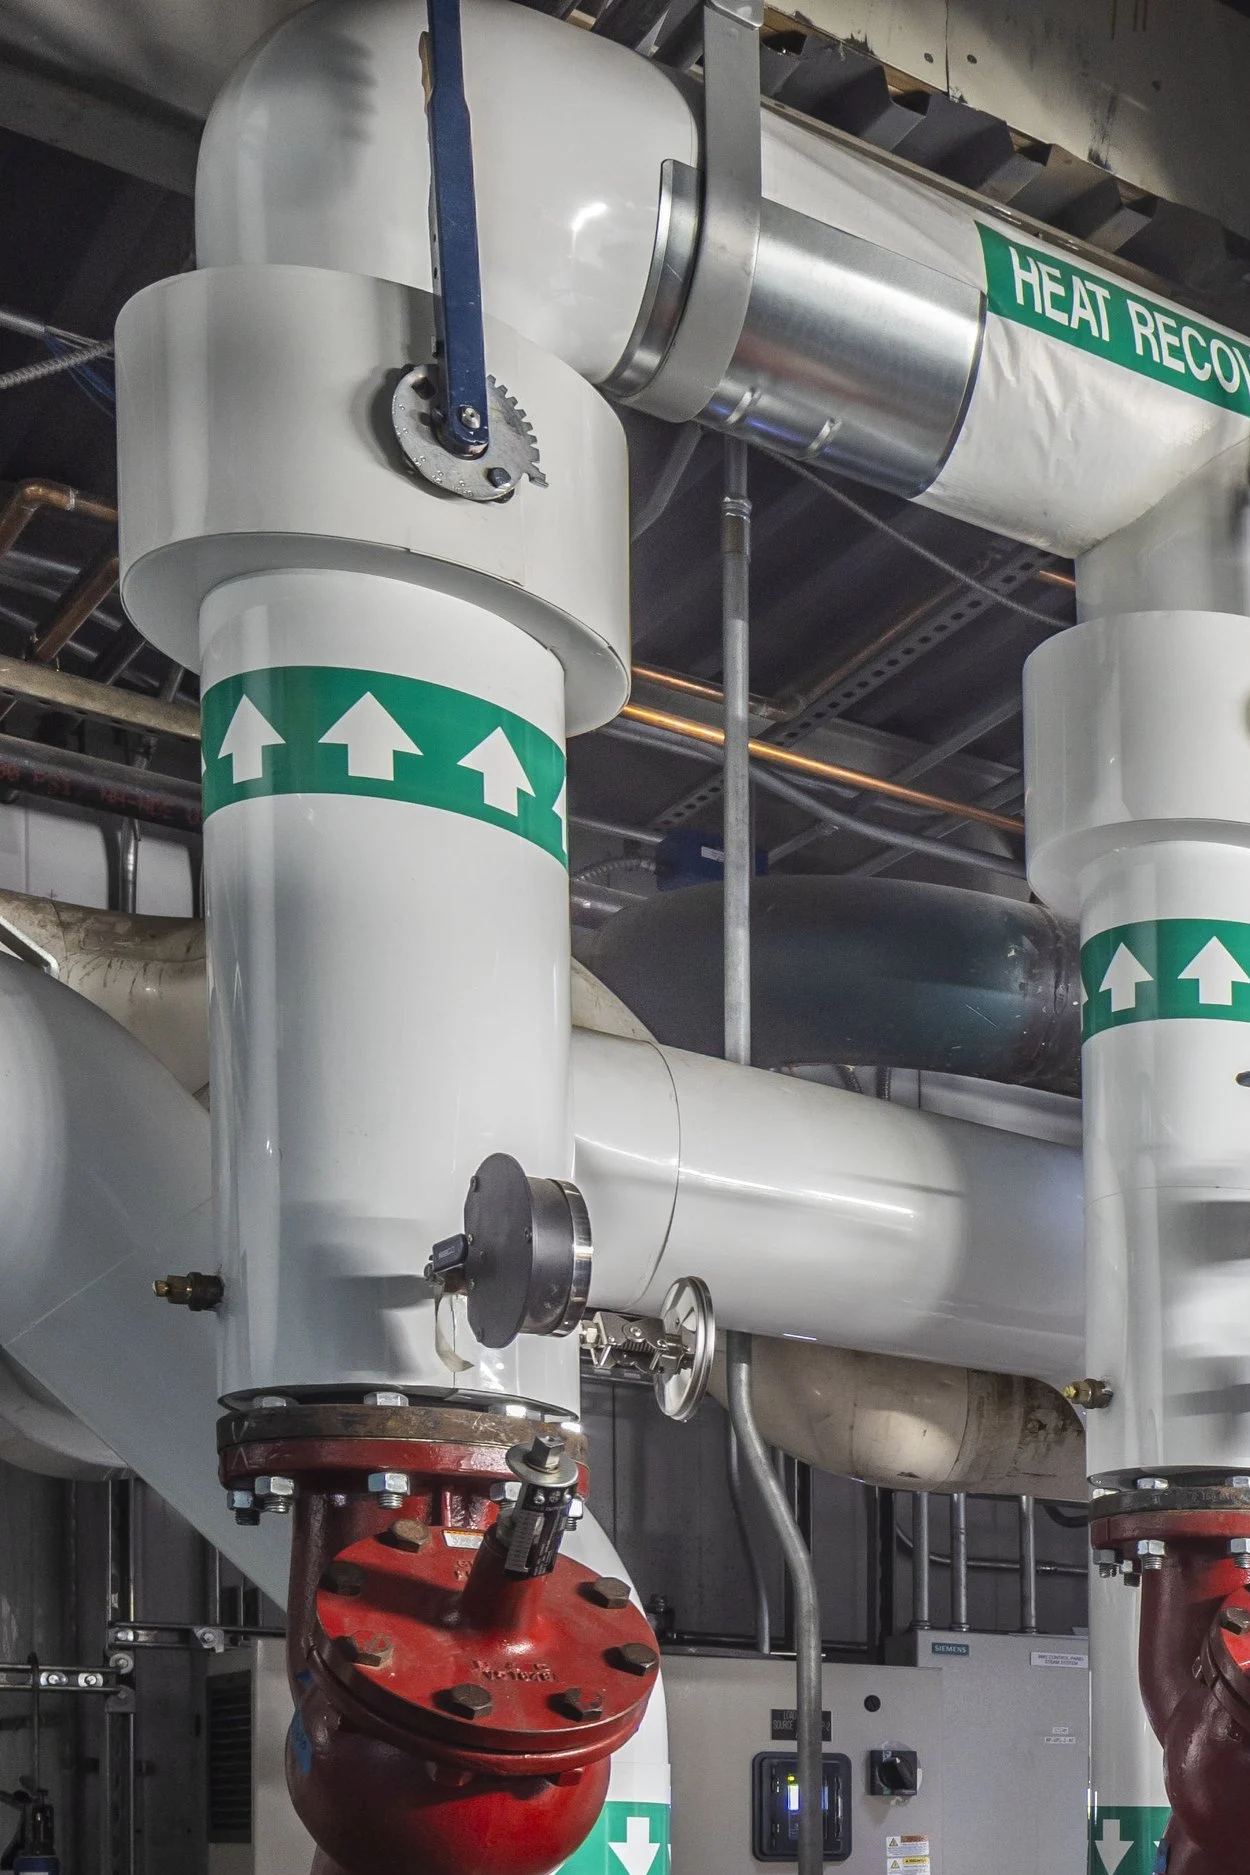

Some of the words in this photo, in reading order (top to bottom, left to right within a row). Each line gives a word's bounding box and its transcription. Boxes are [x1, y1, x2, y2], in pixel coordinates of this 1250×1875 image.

[1008, 246, 1111, 342] HEAT
[934, 1644, 967, 1653] SIEMENS
[773, 1720, 794, 1730] SOURCE
